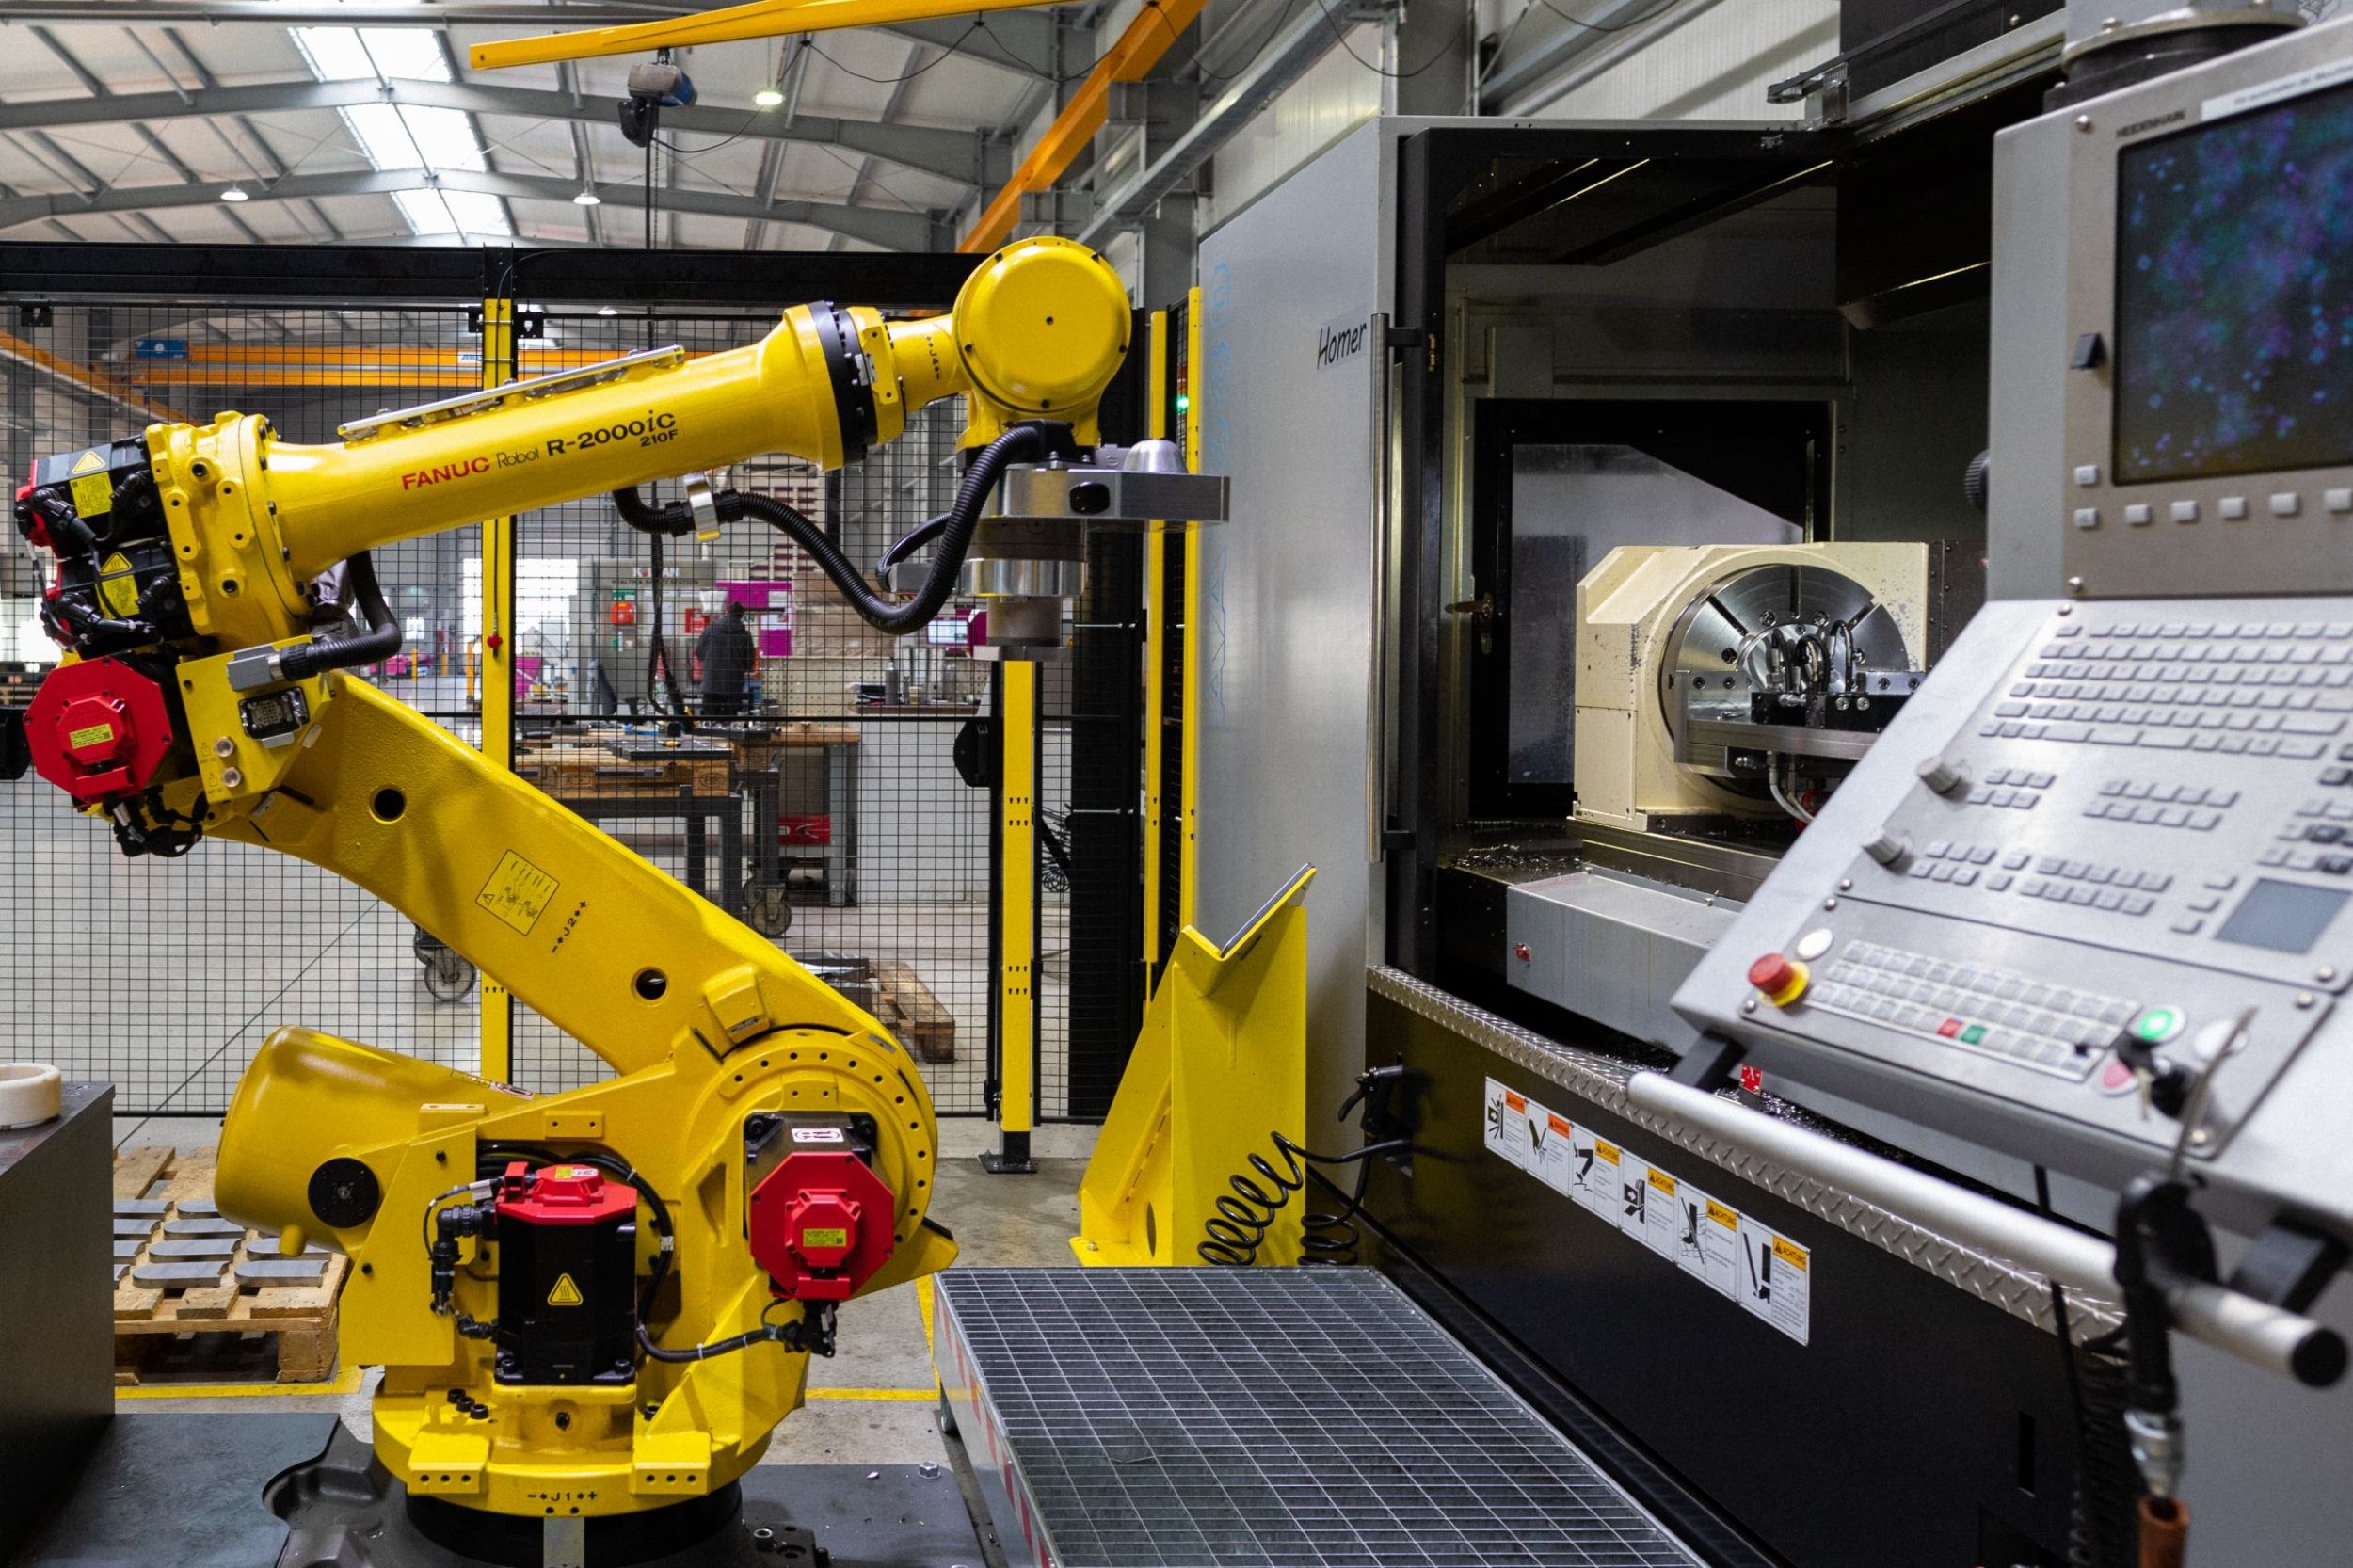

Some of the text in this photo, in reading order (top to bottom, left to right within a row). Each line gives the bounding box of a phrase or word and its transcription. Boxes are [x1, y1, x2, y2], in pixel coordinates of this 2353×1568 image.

[1317, 322, 1367, 370] Homer
[401, 409, 677, 491] FANUC Robot R-2000iC
[639, 428, 678, 447] 210F
